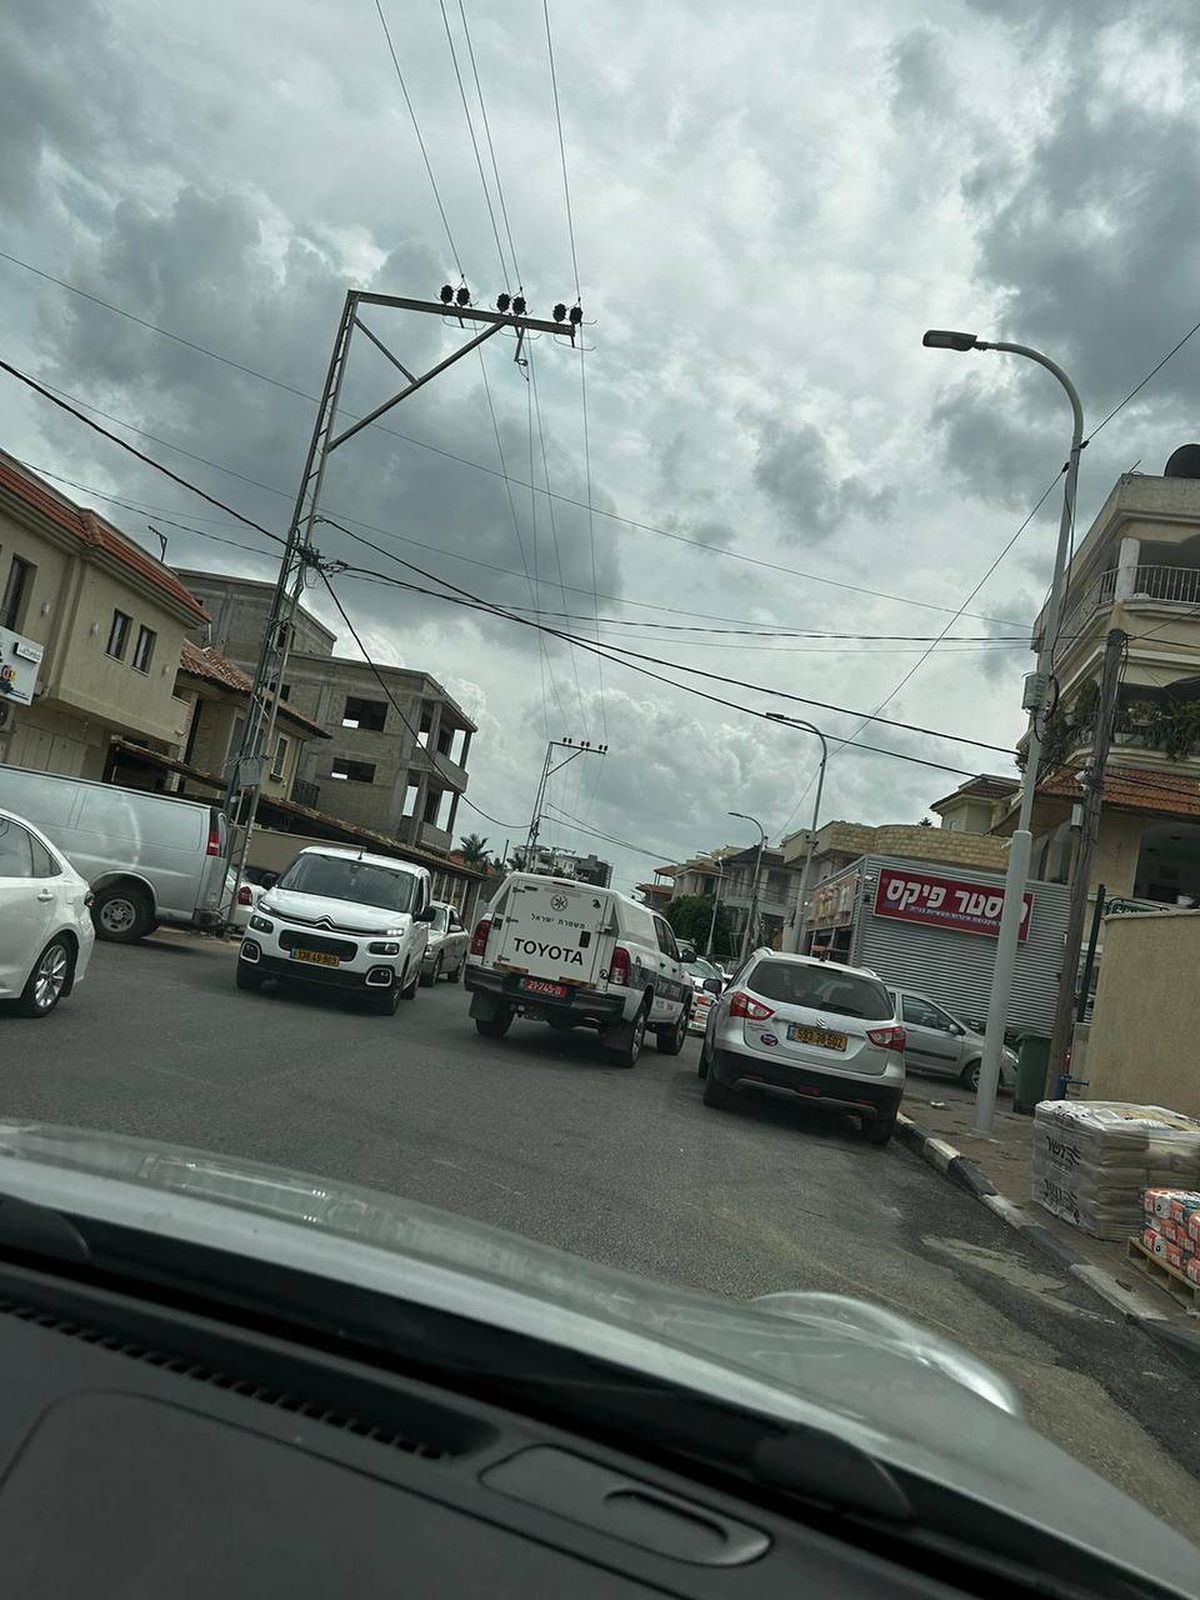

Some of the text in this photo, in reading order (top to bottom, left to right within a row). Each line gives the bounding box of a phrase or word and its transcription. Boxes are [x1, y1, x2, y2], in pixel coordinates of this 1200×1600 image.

[886, 879, 947, 911] פיקס
[530, 912, 555, 923] ישראל
[513, 937, 583, 966] TOYOTA
